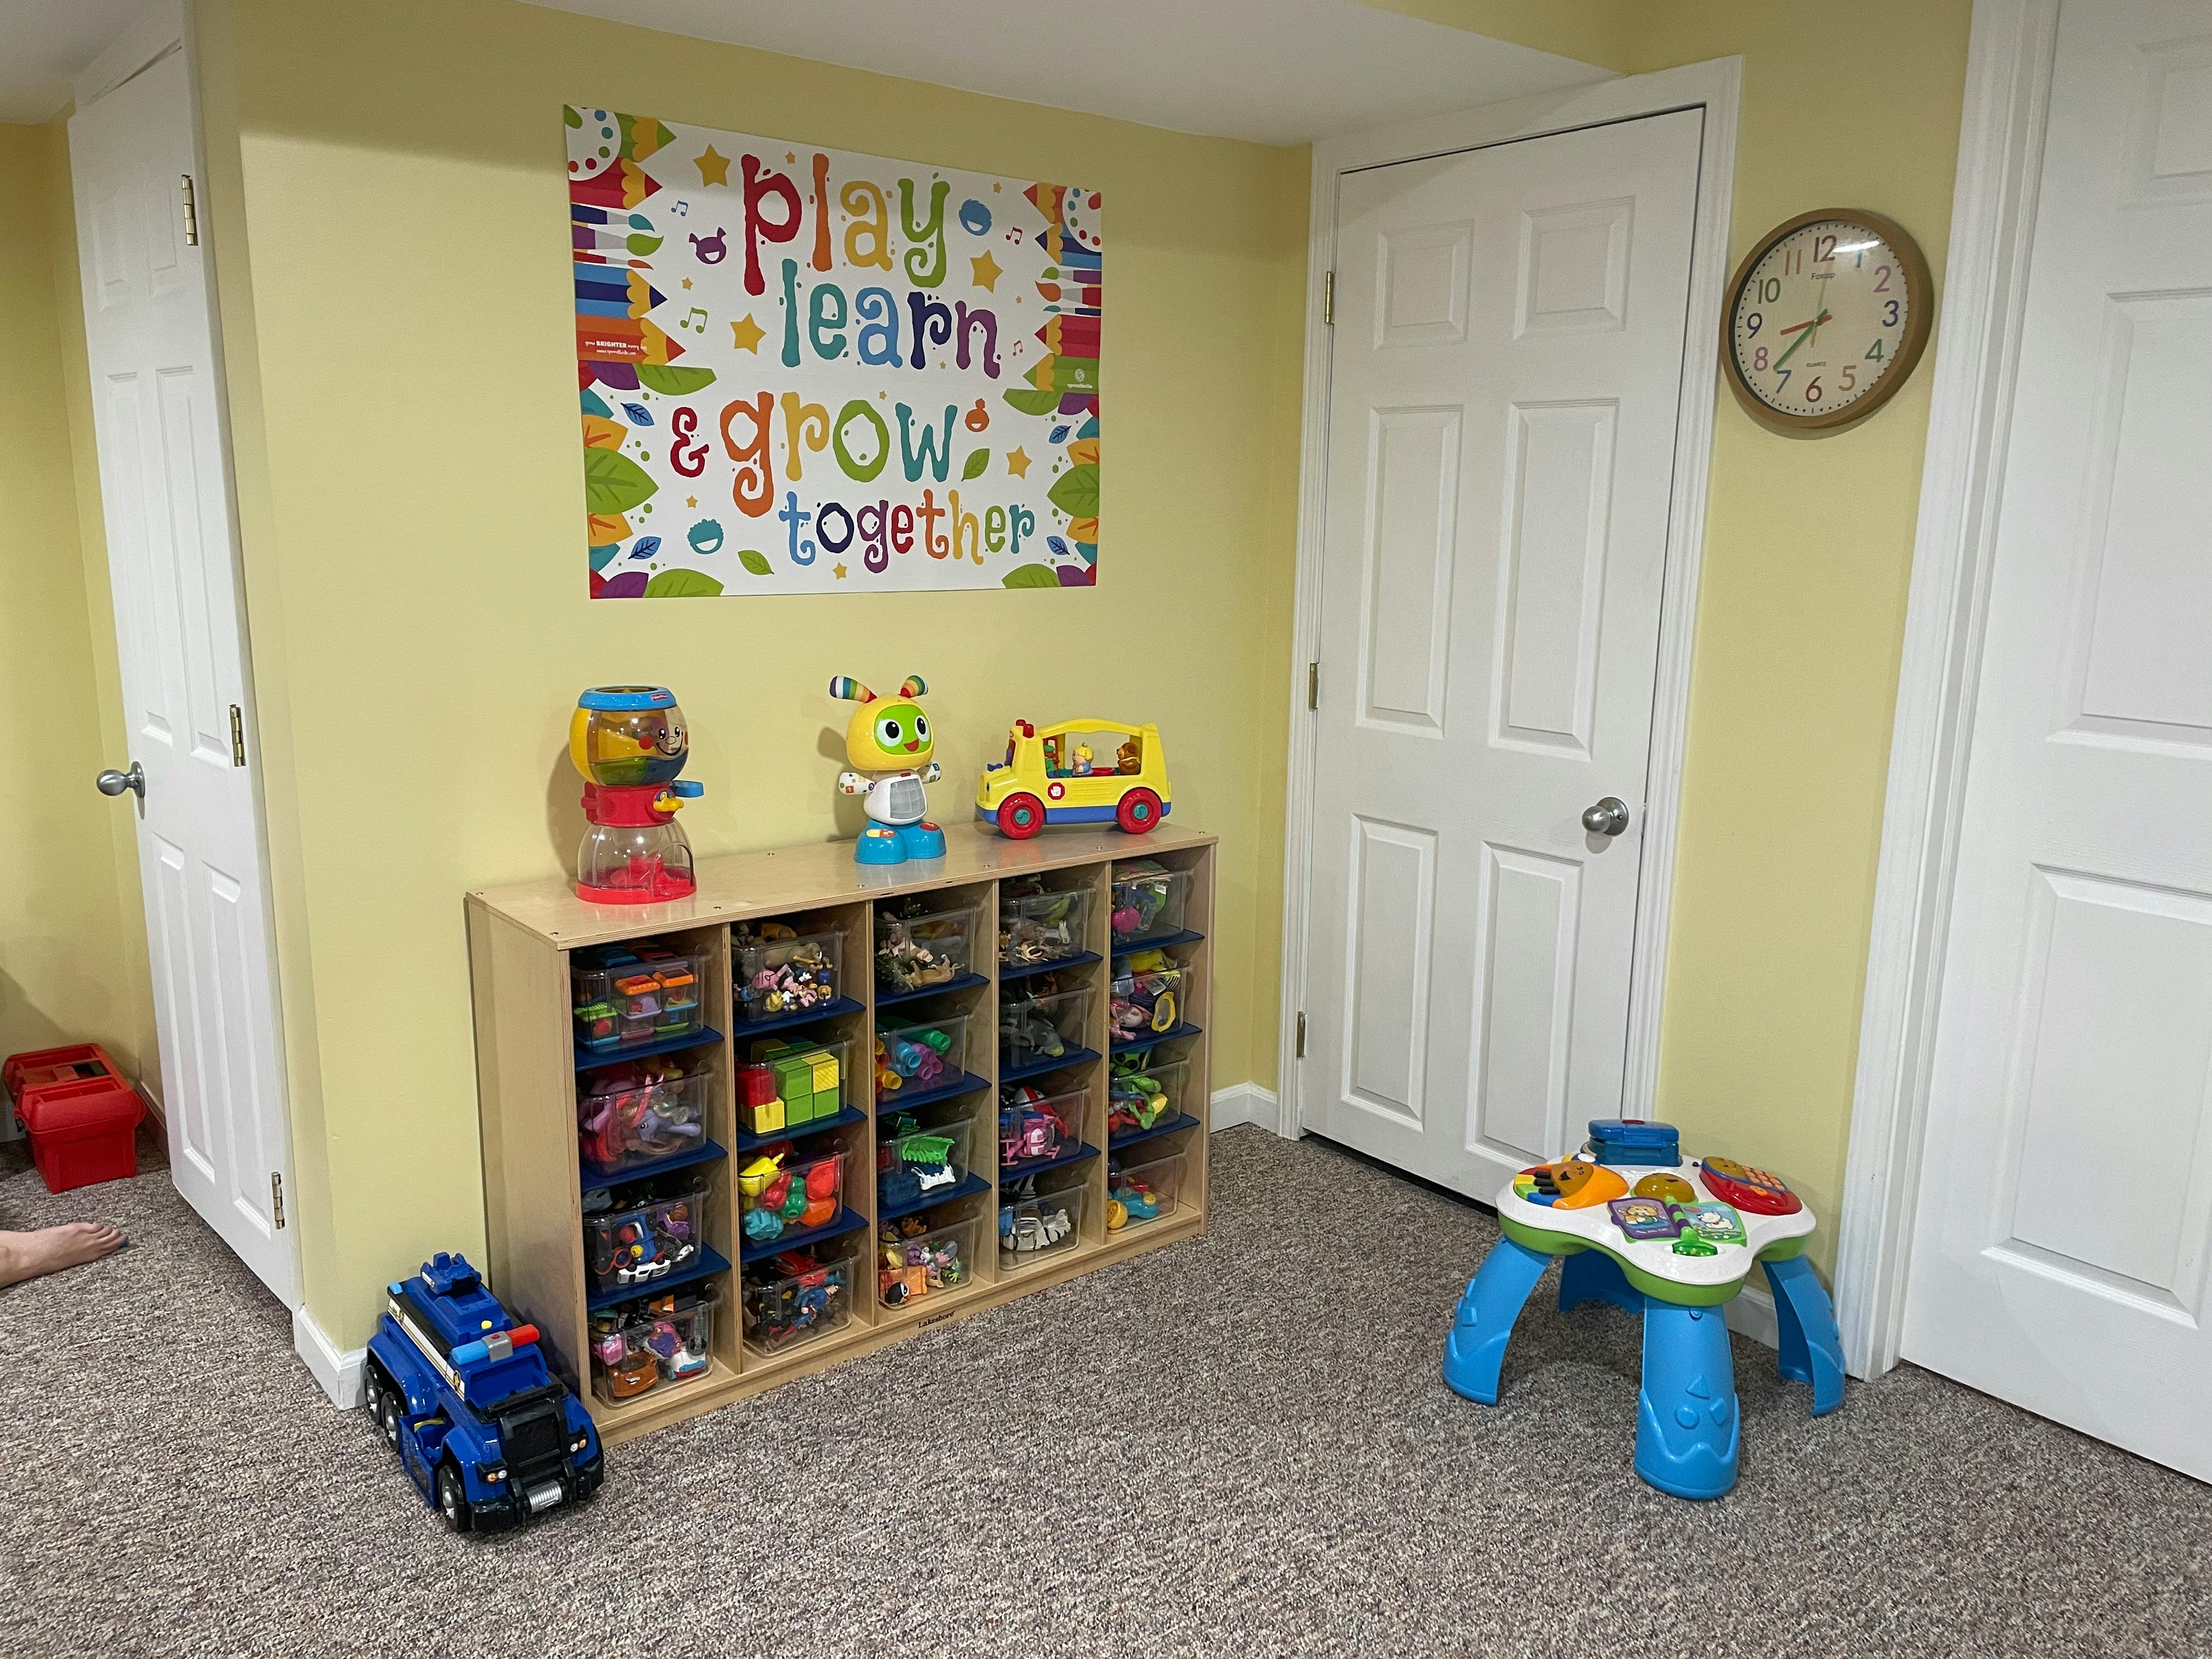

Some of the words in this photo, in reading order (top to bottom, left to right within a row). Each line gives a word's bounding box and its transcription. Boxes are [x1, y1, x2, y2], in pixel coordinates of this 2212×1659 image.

[740, 153, 950, 296] play
[1813, 234, 1837, 263] 12
[1856, 249, 1864, 268] 1
[1785, 249, 1802, 276] 11
[1757, 277, 1781, 304] 10
[1874, 266, 1892, 293] 2
[780, 258, 1001, 379] learn
[1746, 312, 1763, 339] 9
[1882, 300, 1900, 328] 3
[1753, 346, 1769, 372] 8
[1864, 338, 1884, 363] 4
[1776, 370, 1792, 394] 7
[1805, 376, 1822, 403] 6
[1838, 365, 1857, 392] 5
[670, 407, 709, 477] &
[719, 391, 958, 517] grow
[778, 489, 1036, 573] together
